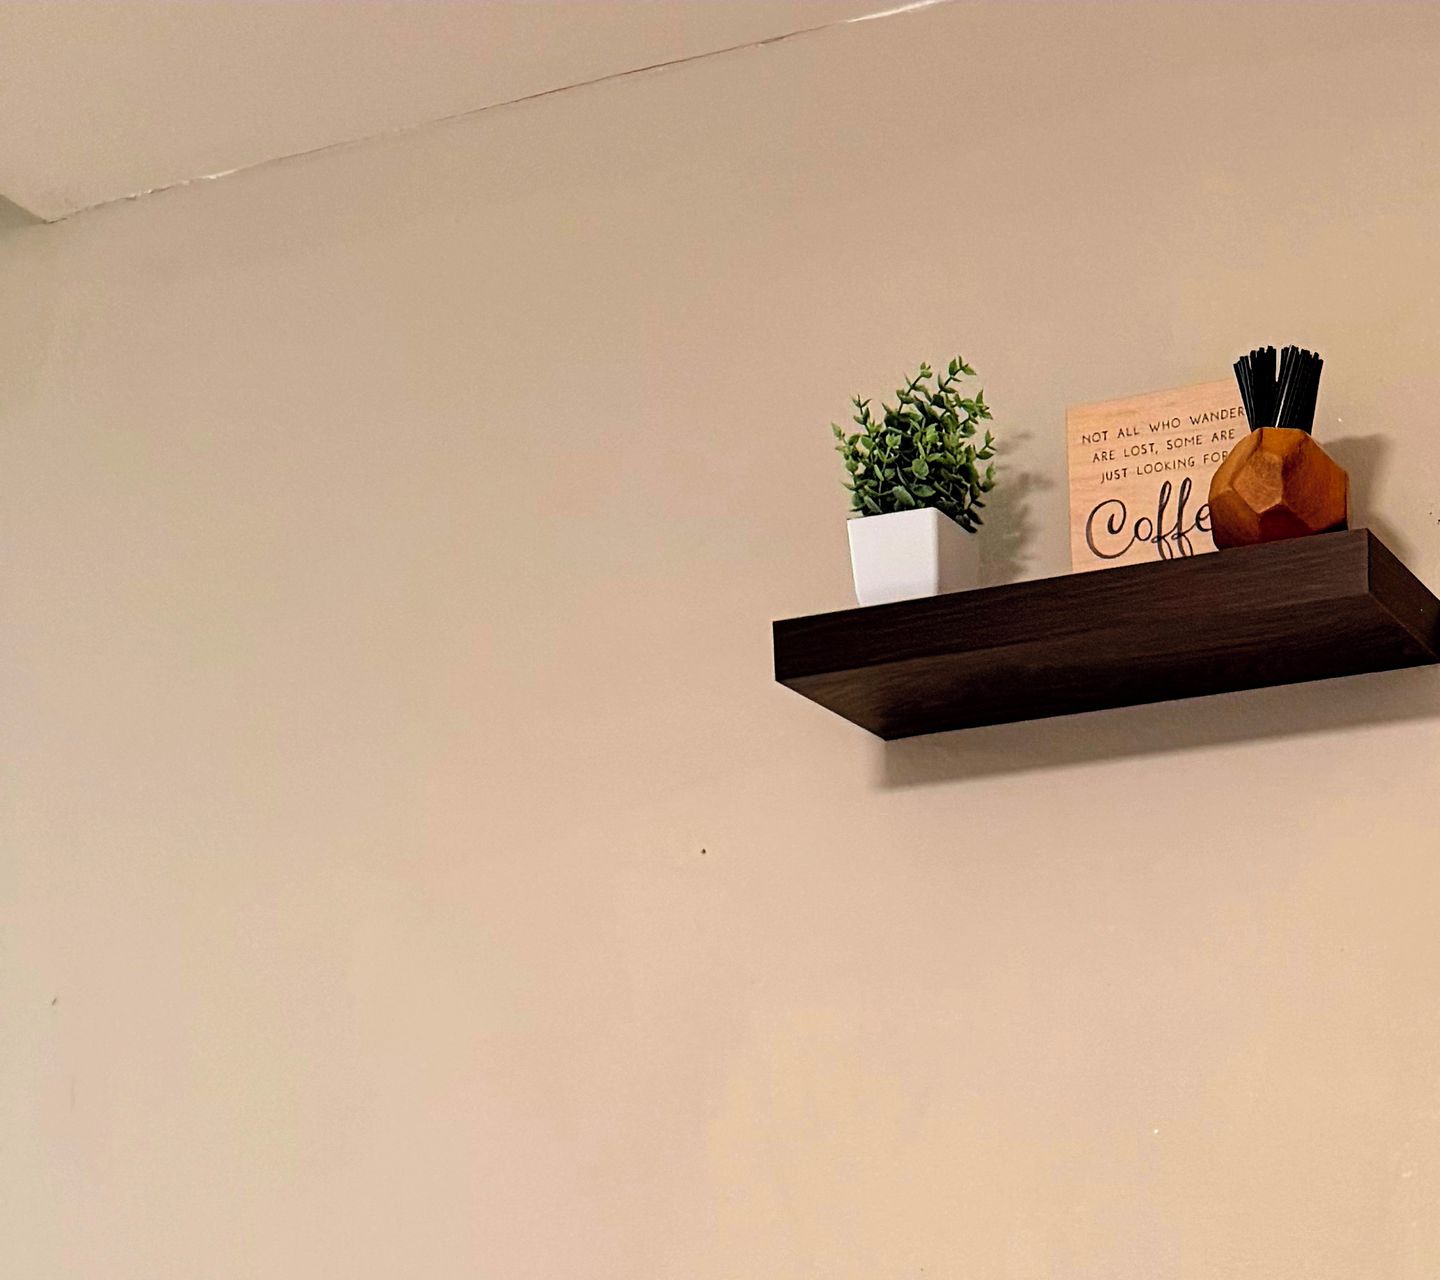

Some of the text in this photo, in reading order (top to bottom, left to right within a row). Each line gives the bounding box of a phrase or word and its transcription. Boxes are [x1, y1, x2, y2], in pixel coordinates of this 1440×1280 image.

[1082, 406, 1246, 445] NOT ALL WHO WANDER
[1092, 428, 1236, 463] ARE LOST, SOME ARE
[1100, 467, 1128, 484] JUST
[1136, 456, 1195, 476] LOOKING
[1085, 476, 1212, 561] Coffe
